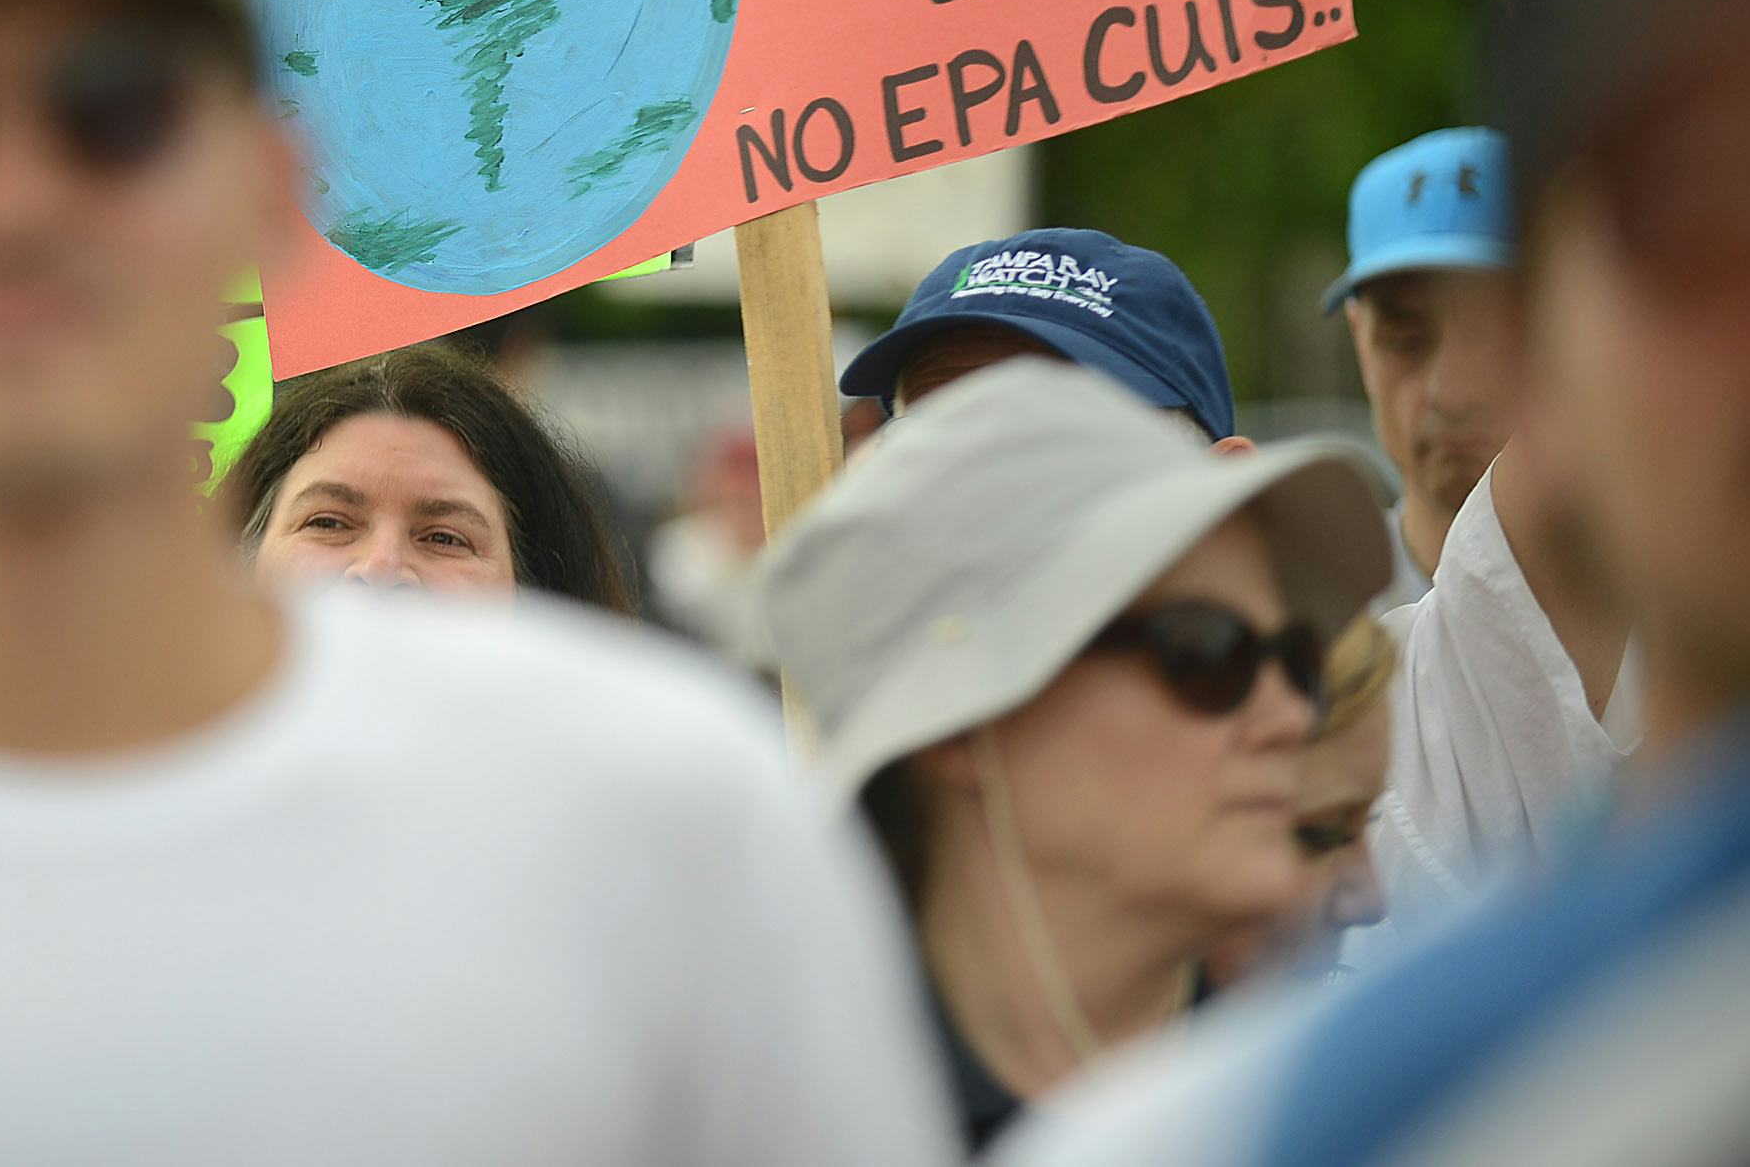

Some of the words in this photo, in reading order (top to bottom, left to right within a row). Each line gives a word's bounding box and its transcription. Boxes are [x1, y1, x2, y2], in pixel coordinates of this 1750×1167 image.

[736, 97, 854, 202] NO
[882, 40, 1060, 162] EPA
[967, 268, 1071, 290] WATCH
[971, 251, 1054, 275] TAMPA
[1056, 255, 1118, 292] BAY
